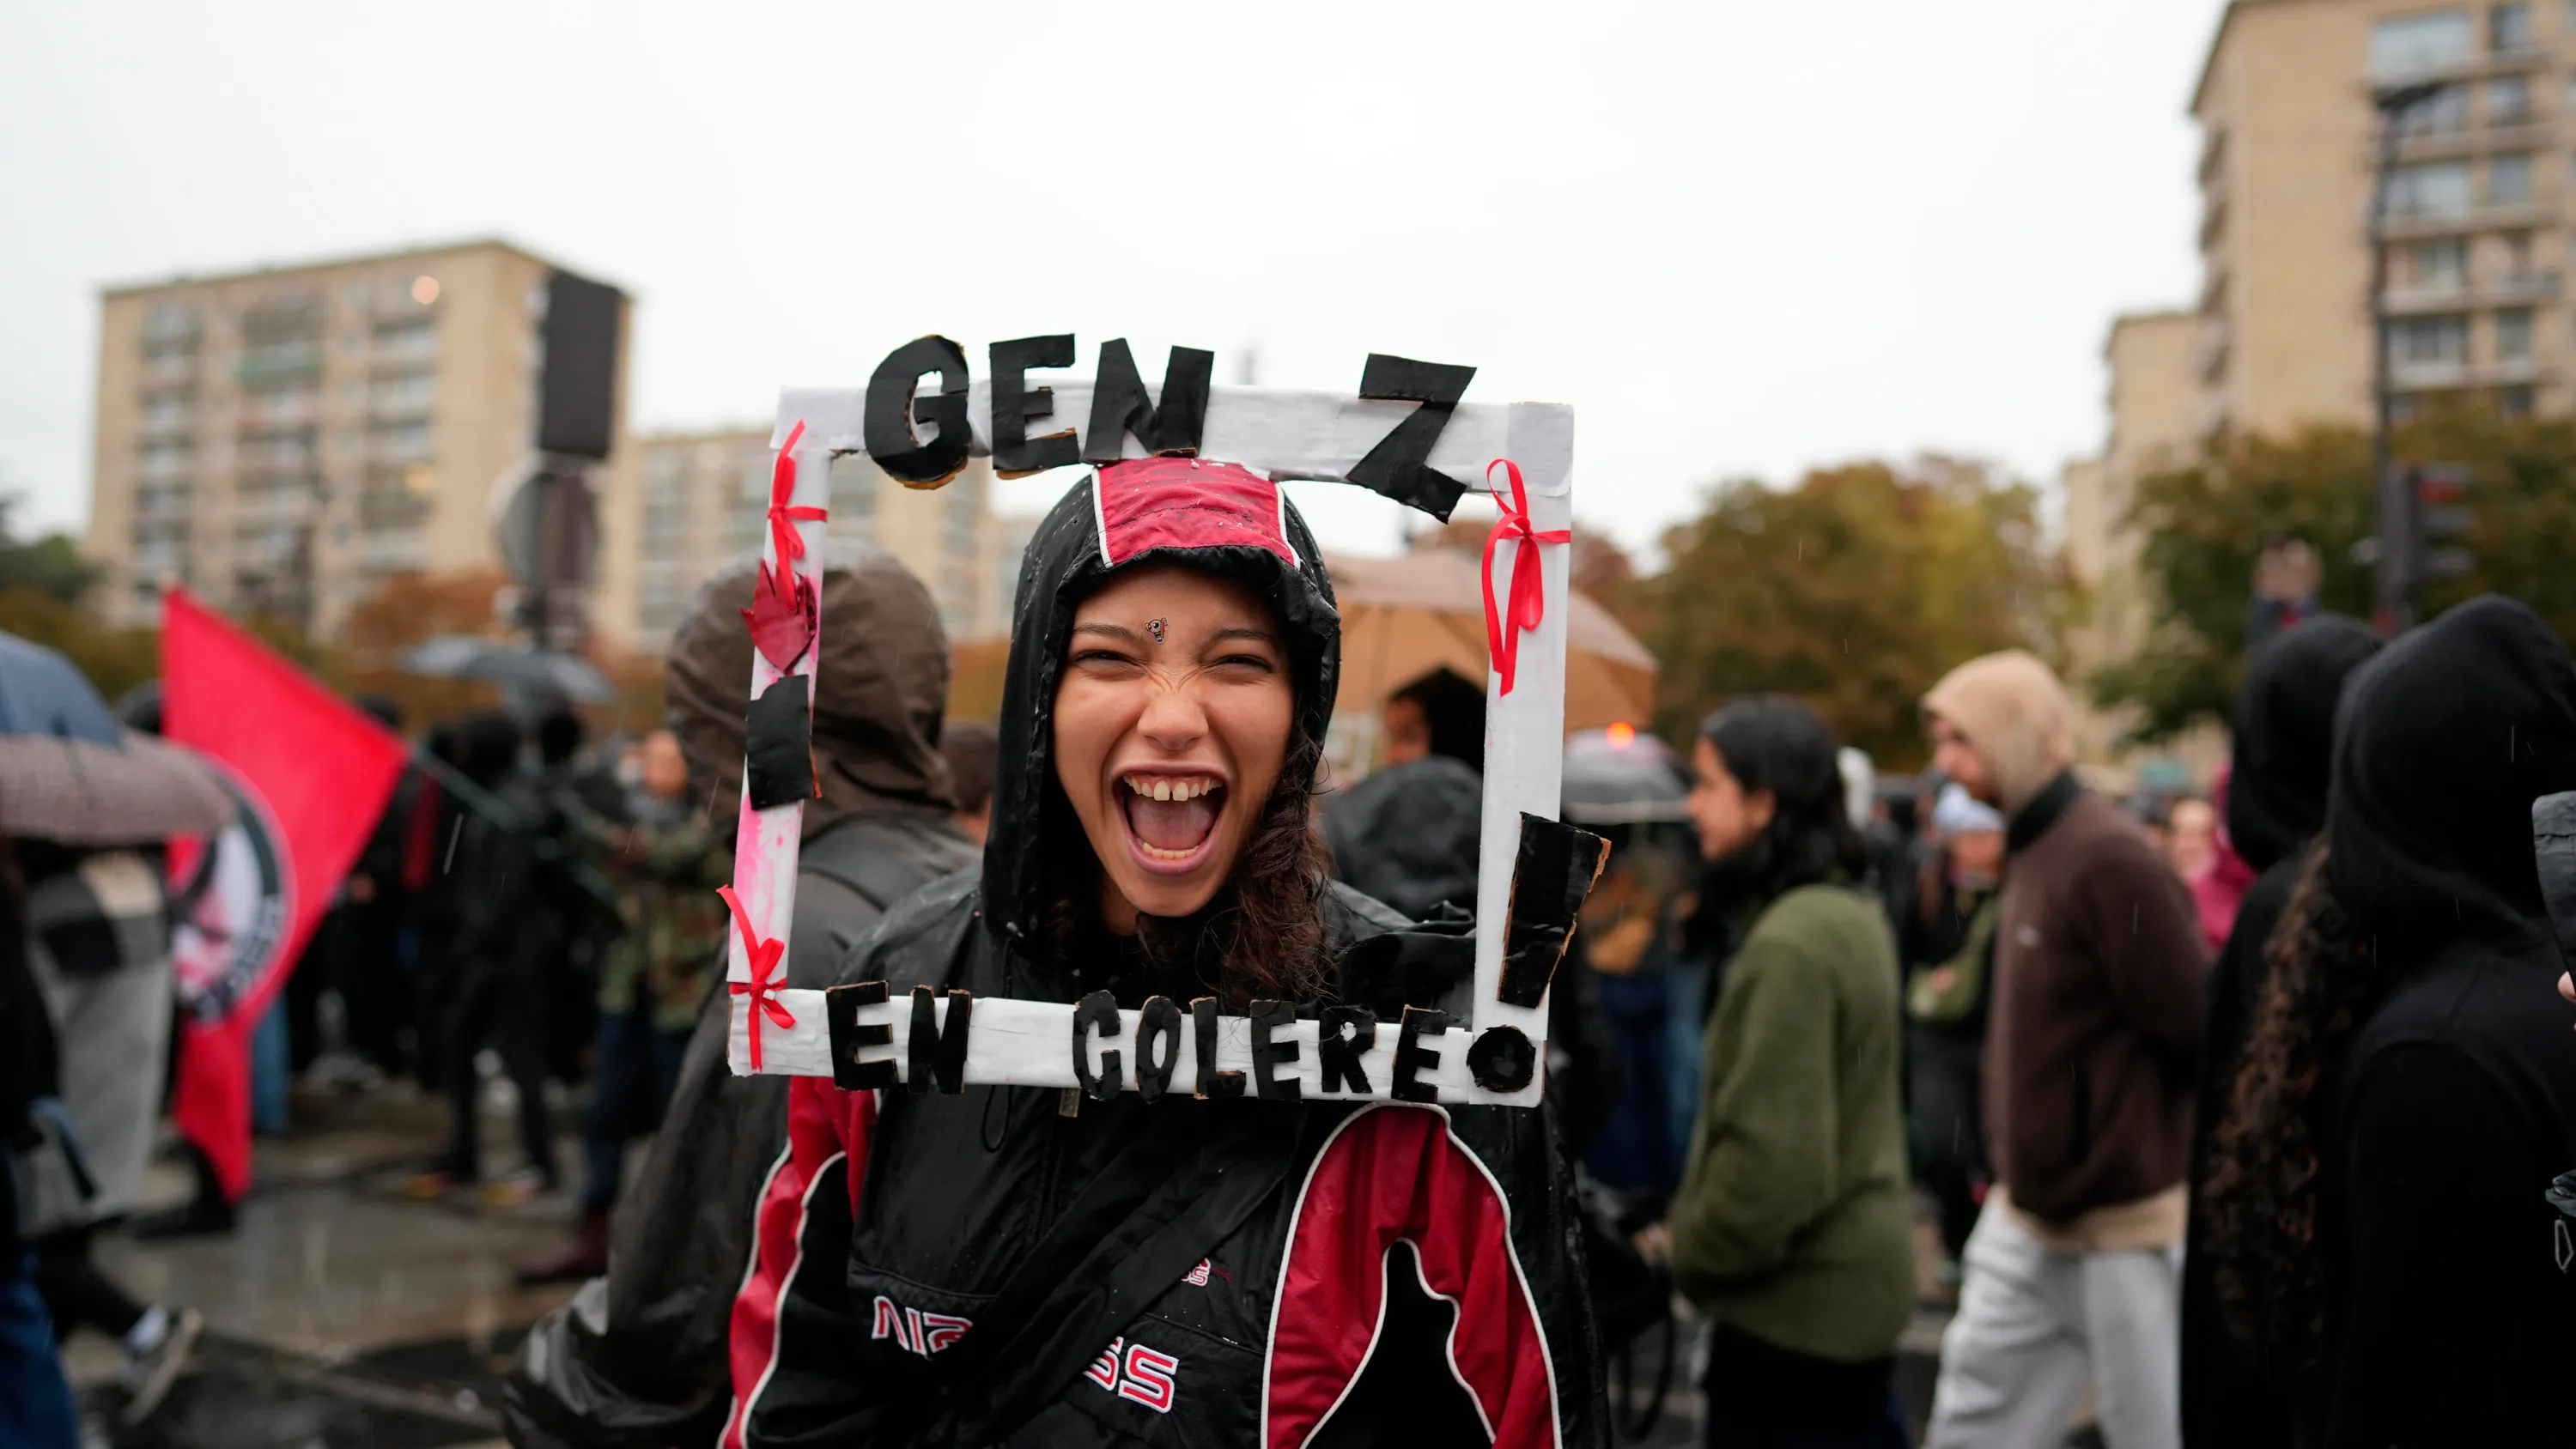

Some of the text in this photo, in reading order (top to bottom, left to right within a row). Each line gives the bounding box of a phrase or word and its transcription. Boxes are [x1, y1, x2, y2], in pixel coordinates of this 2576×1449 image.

[864, 333, 1478, 524] GEN Z
[825, 979, 971, 1094] EN
